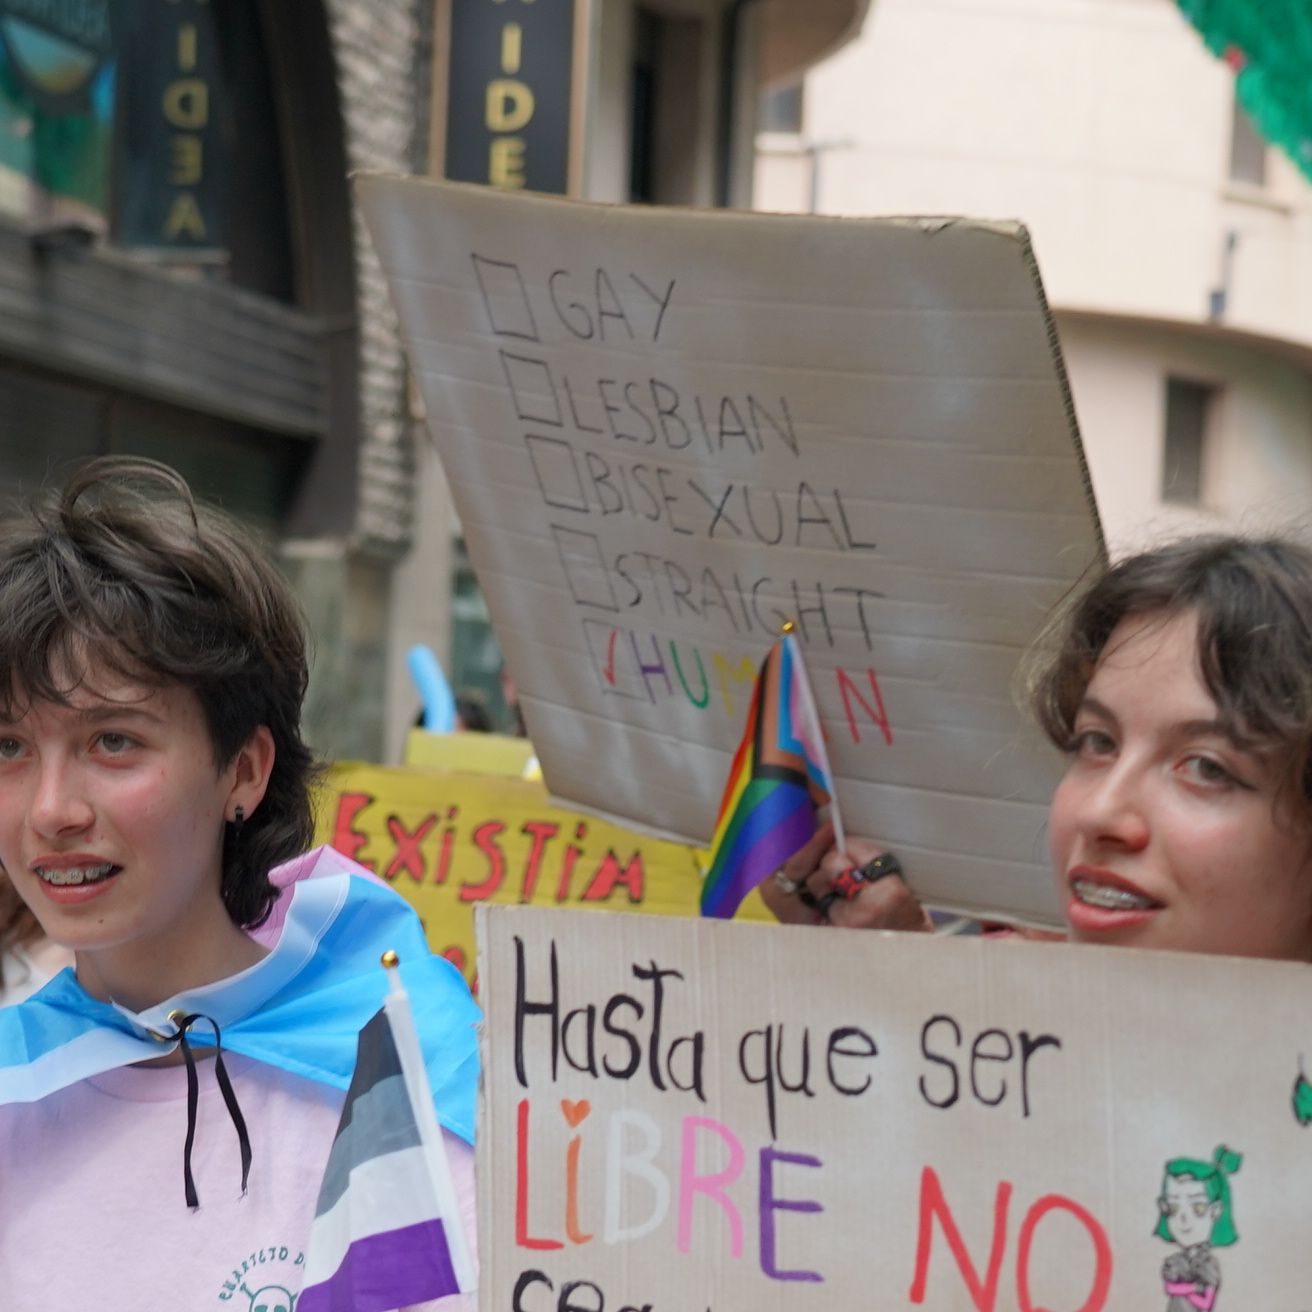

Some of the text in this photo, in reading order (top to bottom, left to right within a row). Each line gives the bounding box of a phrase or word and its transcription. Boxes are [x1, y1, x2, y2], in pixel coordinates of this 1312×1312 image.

[484, 0, 536, 190] IDE
[549, 267, 676, 342] GAY
[563, 376, 801, 457] LESBIAN
[583, 450, 877, 549] BISEXUAL
[614, 552, 890, 651] STRAIGHT
[629, 629, 893, 746] HUMN
[513, 935, 708, 1101] Hasta
[738, 1023, 879, 1139] que
[918, 1014, 1062, 1117] ser
